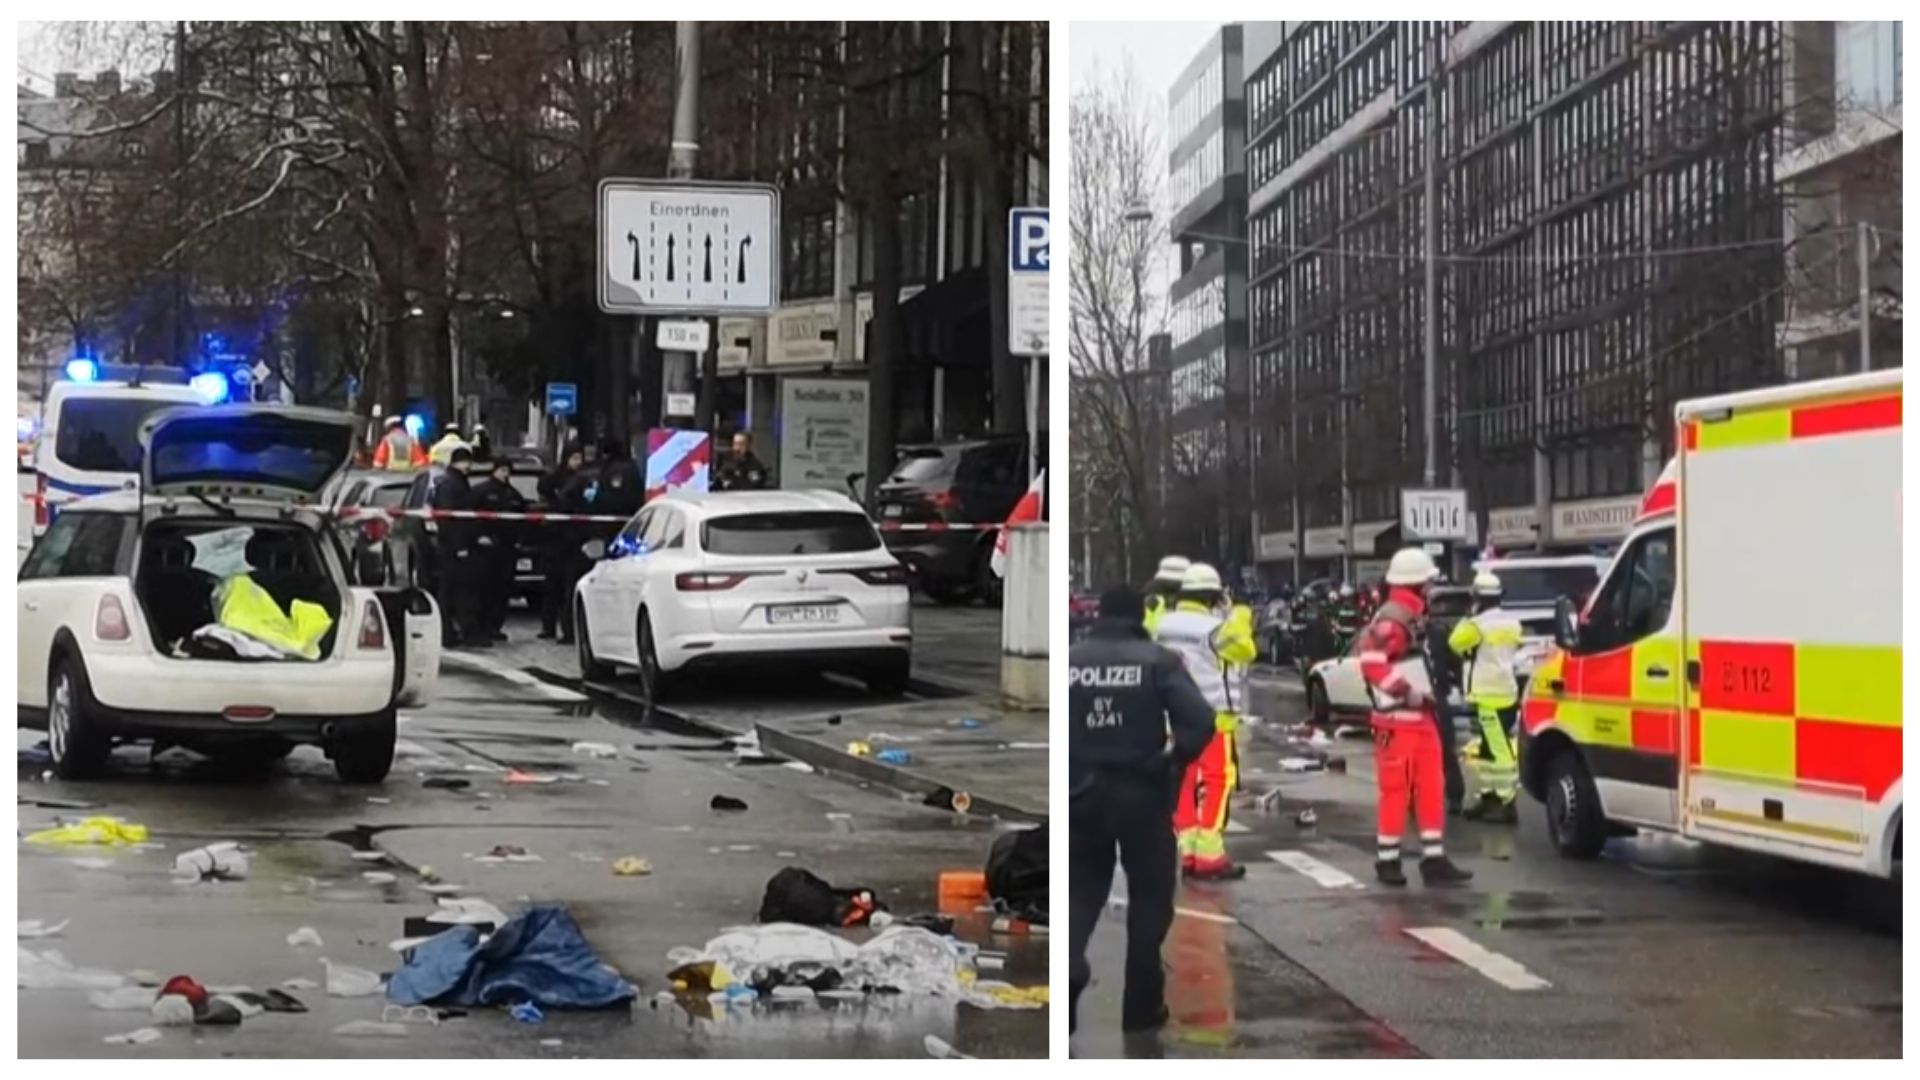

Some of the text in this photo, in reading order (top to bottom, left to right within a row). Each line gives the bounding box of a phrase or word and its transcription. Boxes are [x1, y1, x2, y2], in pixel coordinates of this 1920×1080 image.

[650, 200, 729, 218] Einordnen
[1020, 216, 1049, 266] P
[1069, 664, 1142, 687] POLIZEI
[1741, 666, 1771, 693] 112
[1094, 696, 1113, 712] BY
[1086, 711, 1123, 729] 6241
